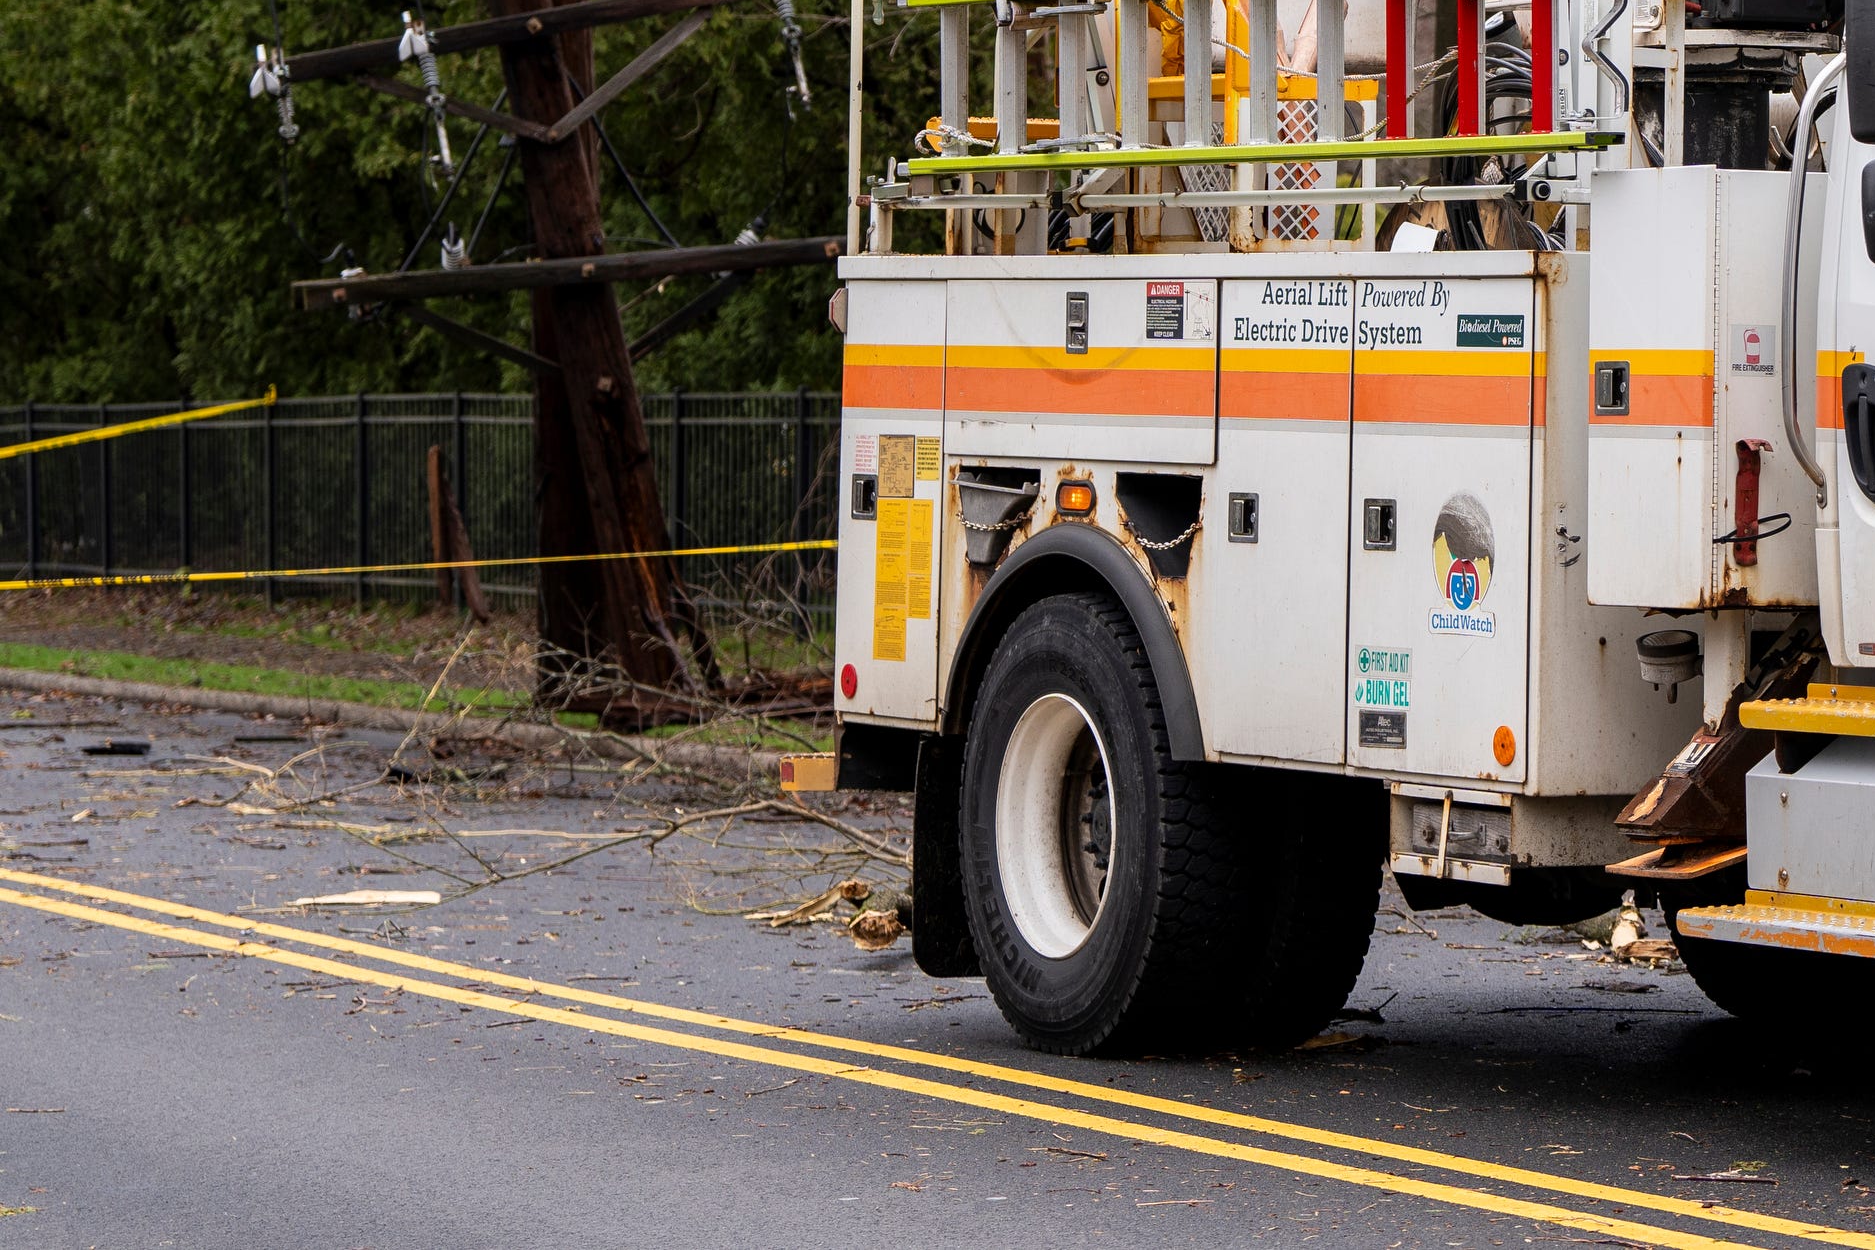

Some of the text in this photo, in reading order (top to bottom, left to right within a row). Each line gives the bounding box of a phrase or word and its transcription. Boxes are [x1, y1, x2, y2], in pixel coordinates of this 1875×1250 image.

[1156, 284, 1180, 295] DANGER
[1262, 281, 1450, 317] Aerial Lift Powered By
[1234, 317, 1422, 350] Electric Drive System
[1459, 319, 1523, 334] Biodiesel Powered
[1371, 651, 1410, 673] FIRST AID KIT
[1366, 679, 1410, 707] BURN GEL
[973, 821, 1043, 991] MICHELIN
